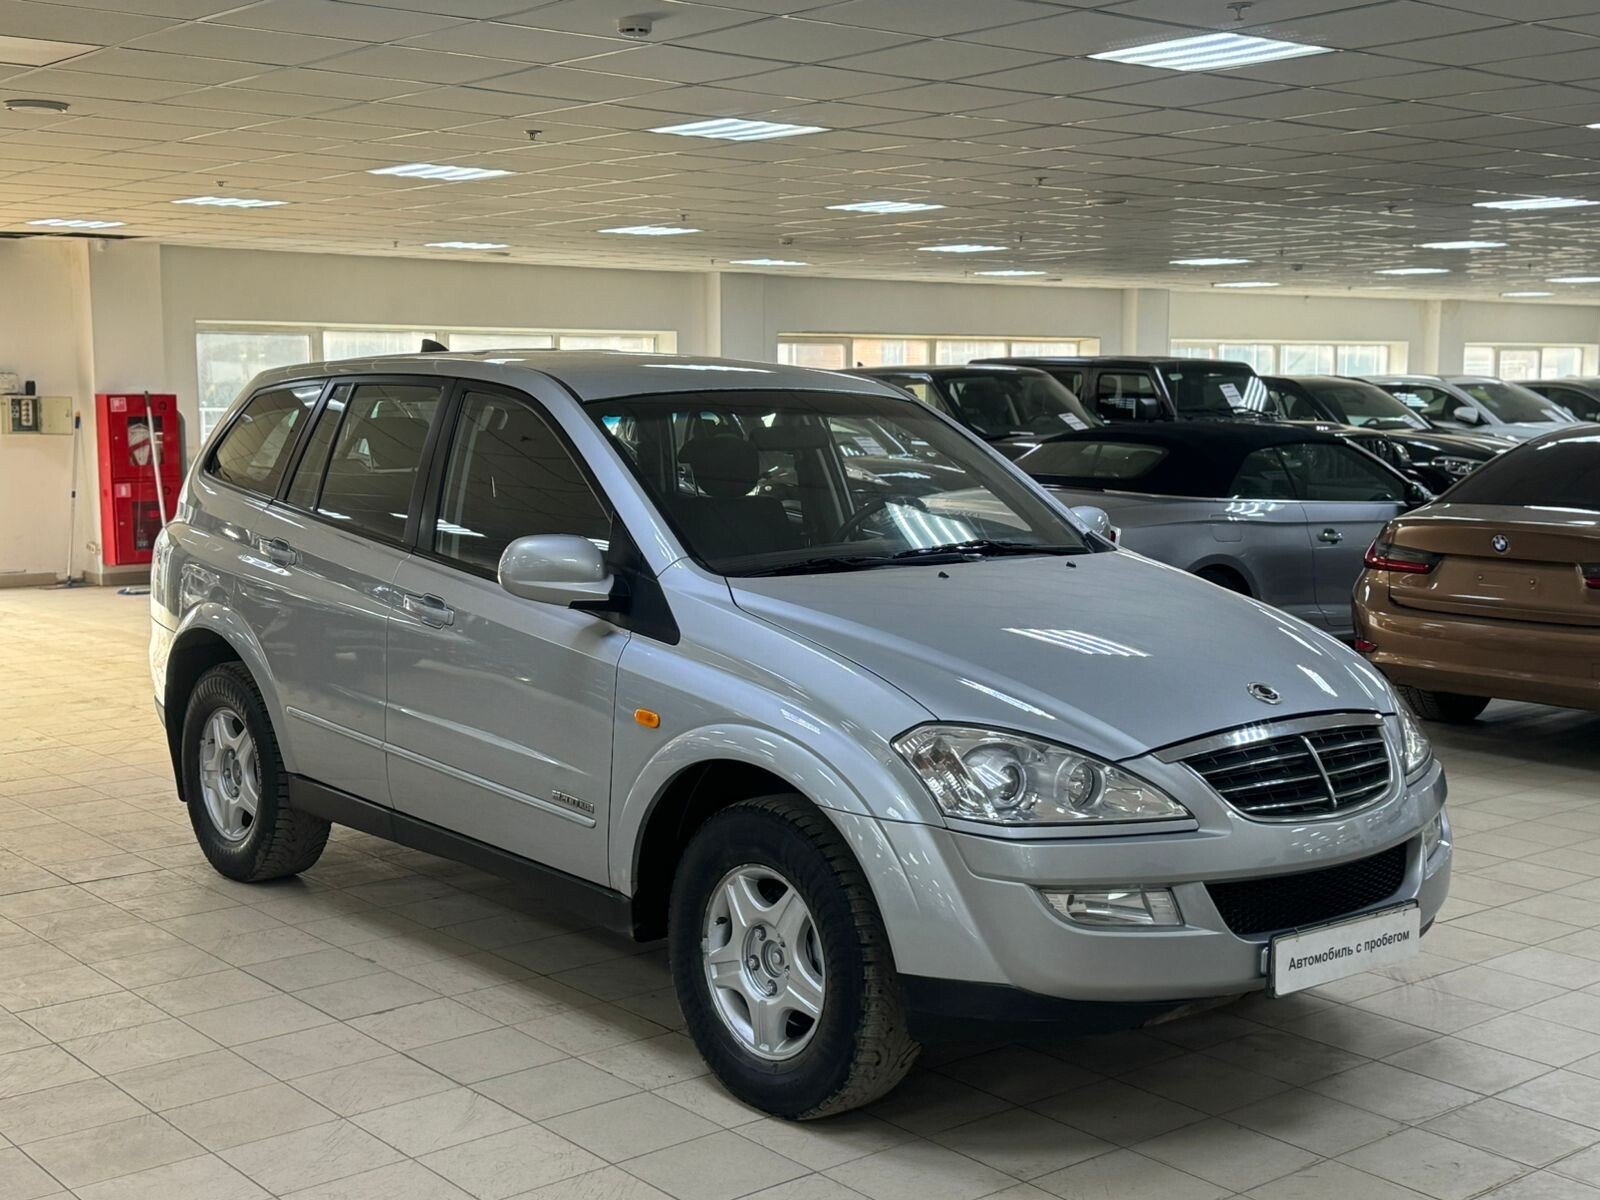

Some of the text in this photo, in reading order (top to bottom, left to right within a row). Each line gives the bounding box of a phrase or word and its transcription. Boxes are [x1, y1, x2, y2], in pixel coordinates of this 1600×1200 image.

[1288, 929, 1410, 971] Автомобиль с пробегом
